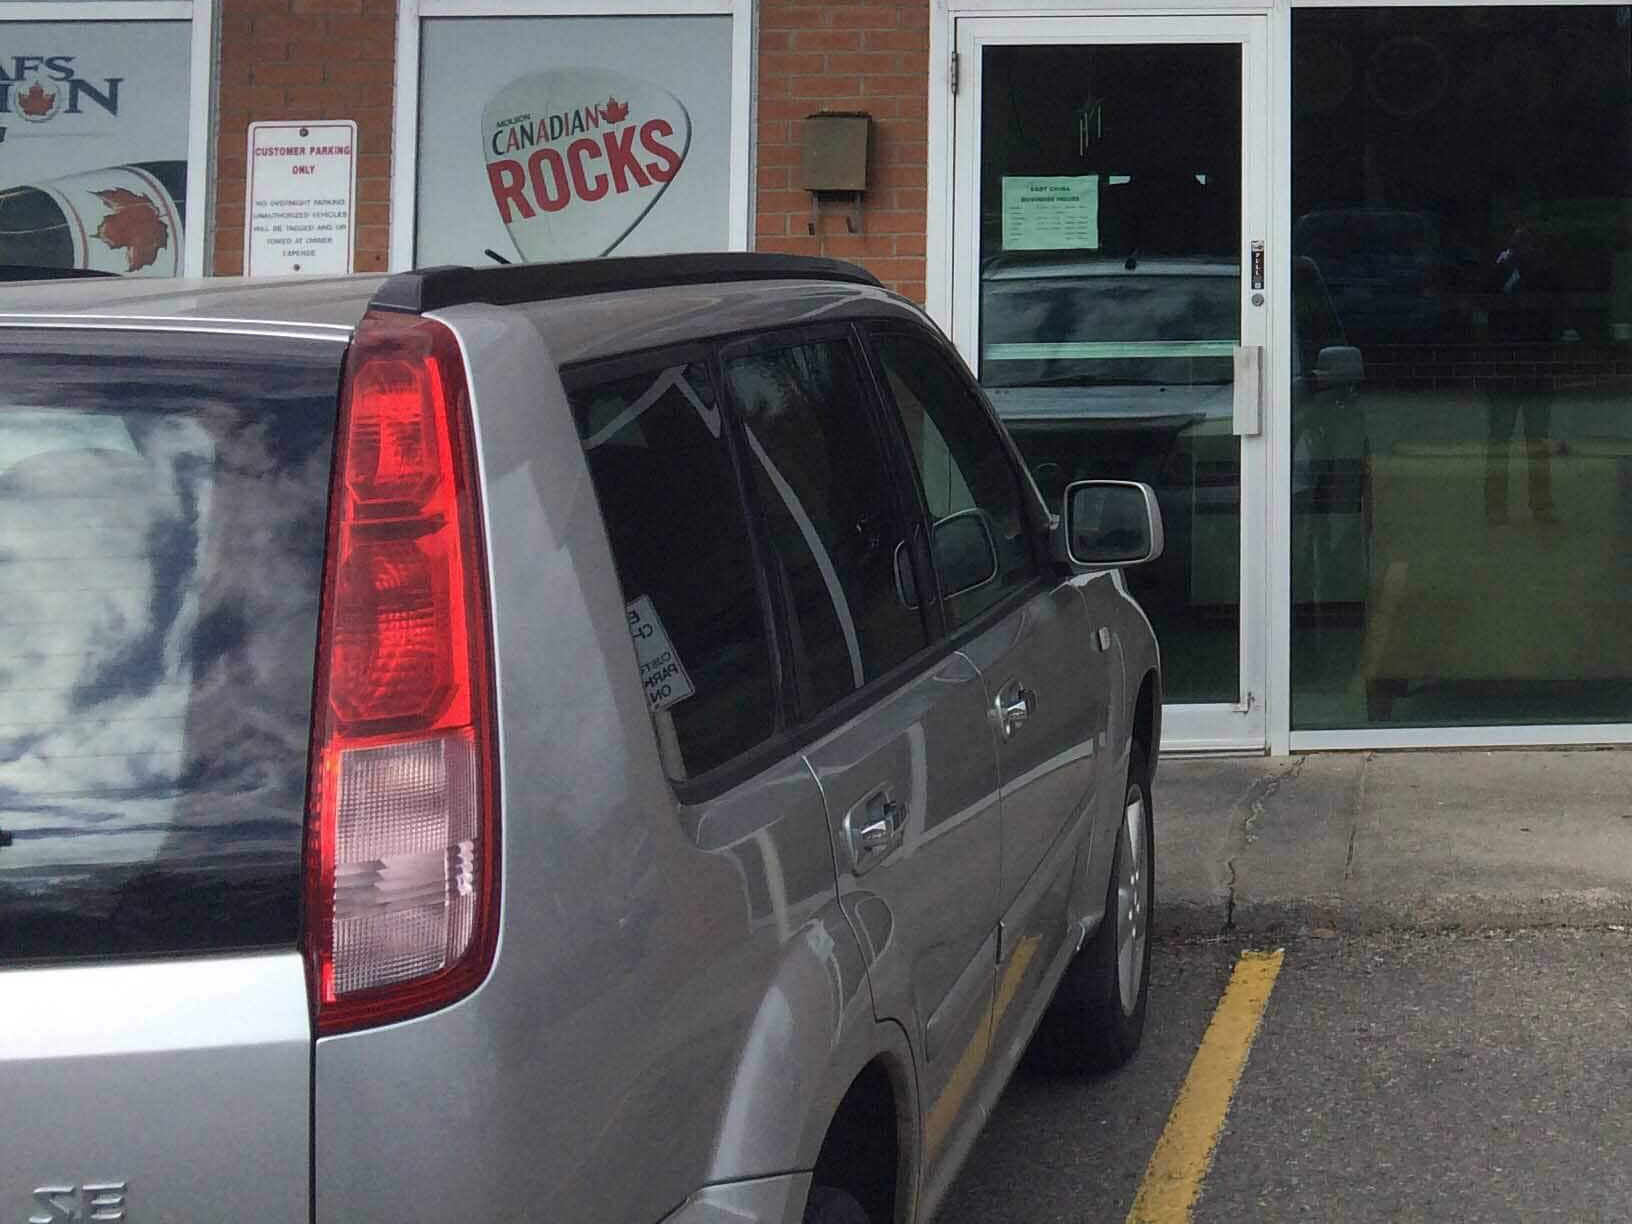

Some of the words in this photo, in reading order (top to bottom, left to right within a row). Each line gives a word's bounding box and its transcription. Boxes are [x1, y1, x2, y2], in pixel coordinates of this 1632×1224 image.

[491, 103, 600, 156] CANADIAN
[255, 147, 305, 156] CUSTOMER
[310, 146, 351, 155] PARKING
[292, 165, 315, 175] ONLY
[486, 118, 682, 225] ROCKS
